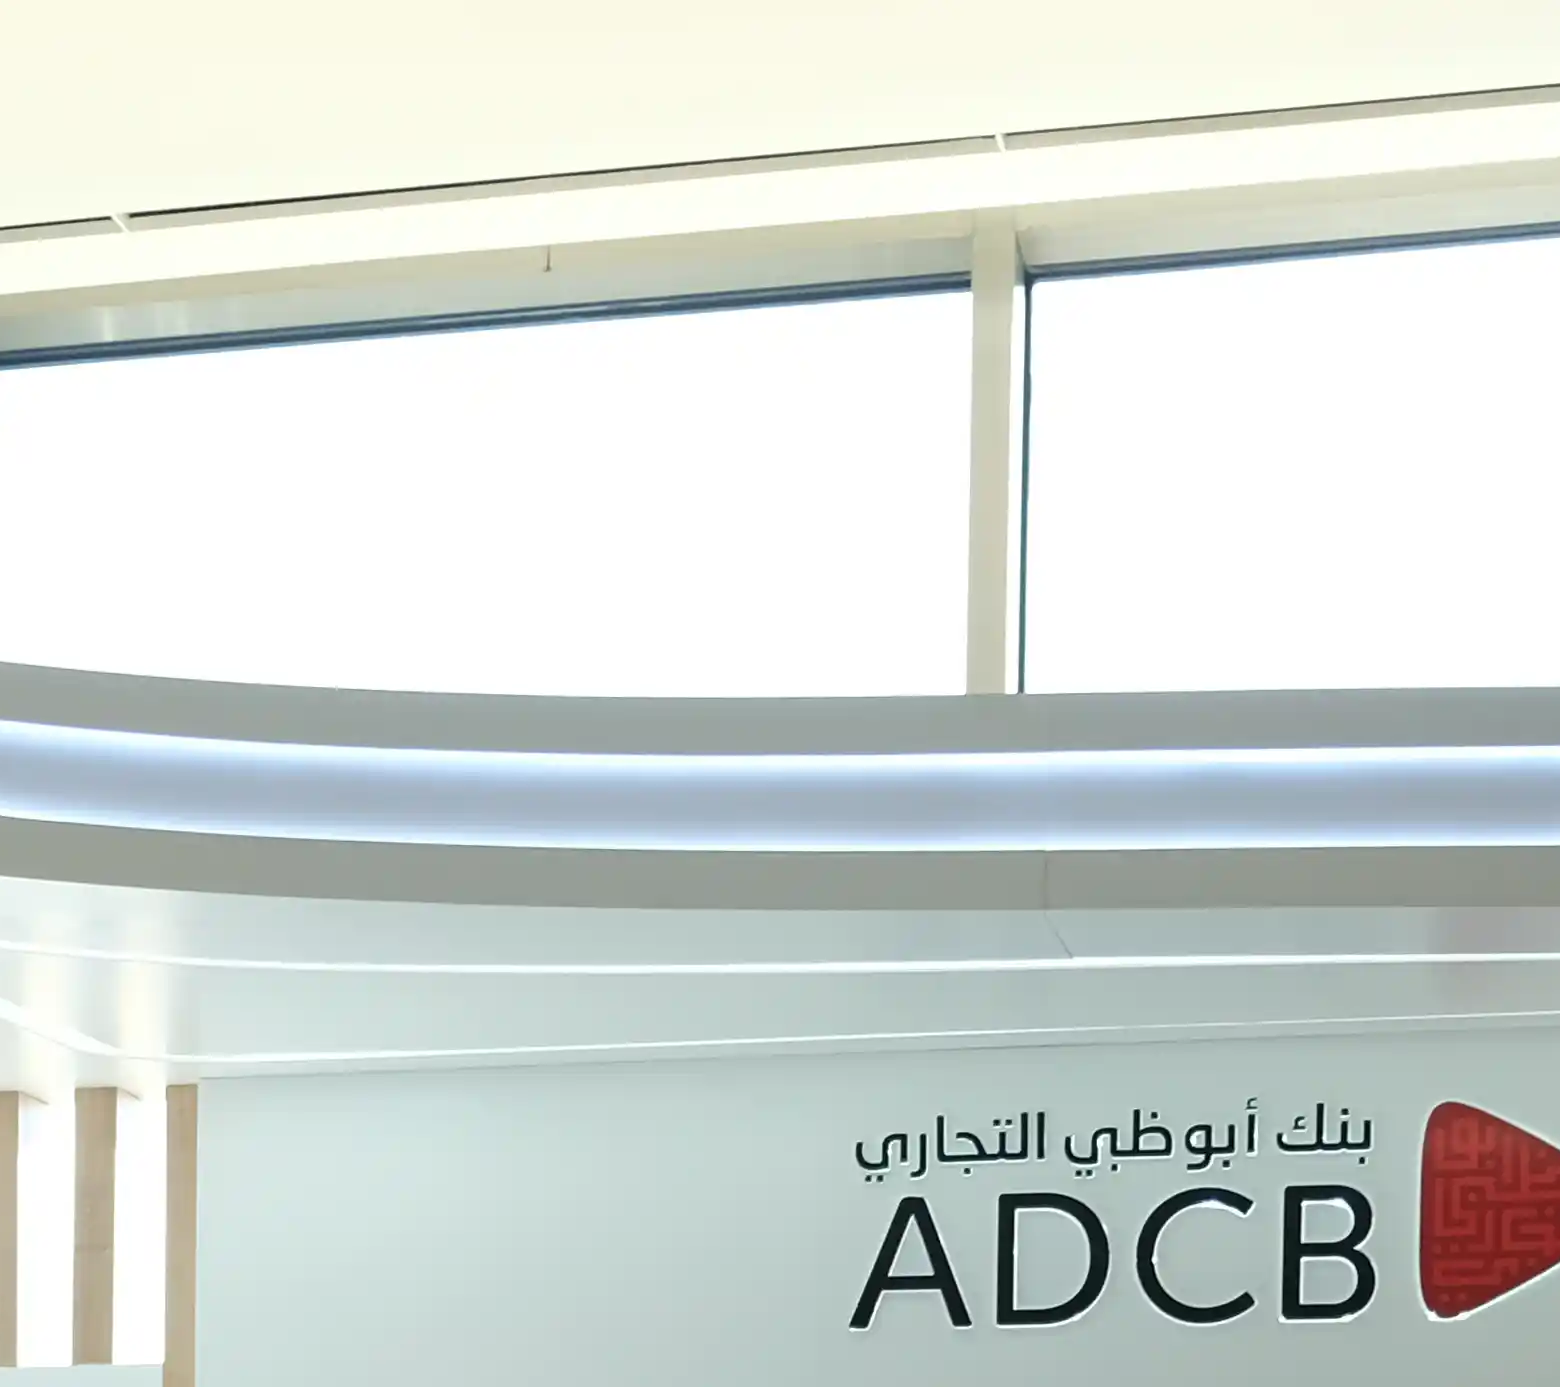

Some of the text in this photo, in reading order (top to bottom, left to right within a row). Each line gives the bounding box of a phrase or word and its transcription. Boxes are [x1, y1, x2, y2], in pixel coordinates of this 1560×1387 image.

[855, 1097, 1372, 1183] بنك أبوظبي التجاري
[848, 1185, 1377, 1330] ADCB
